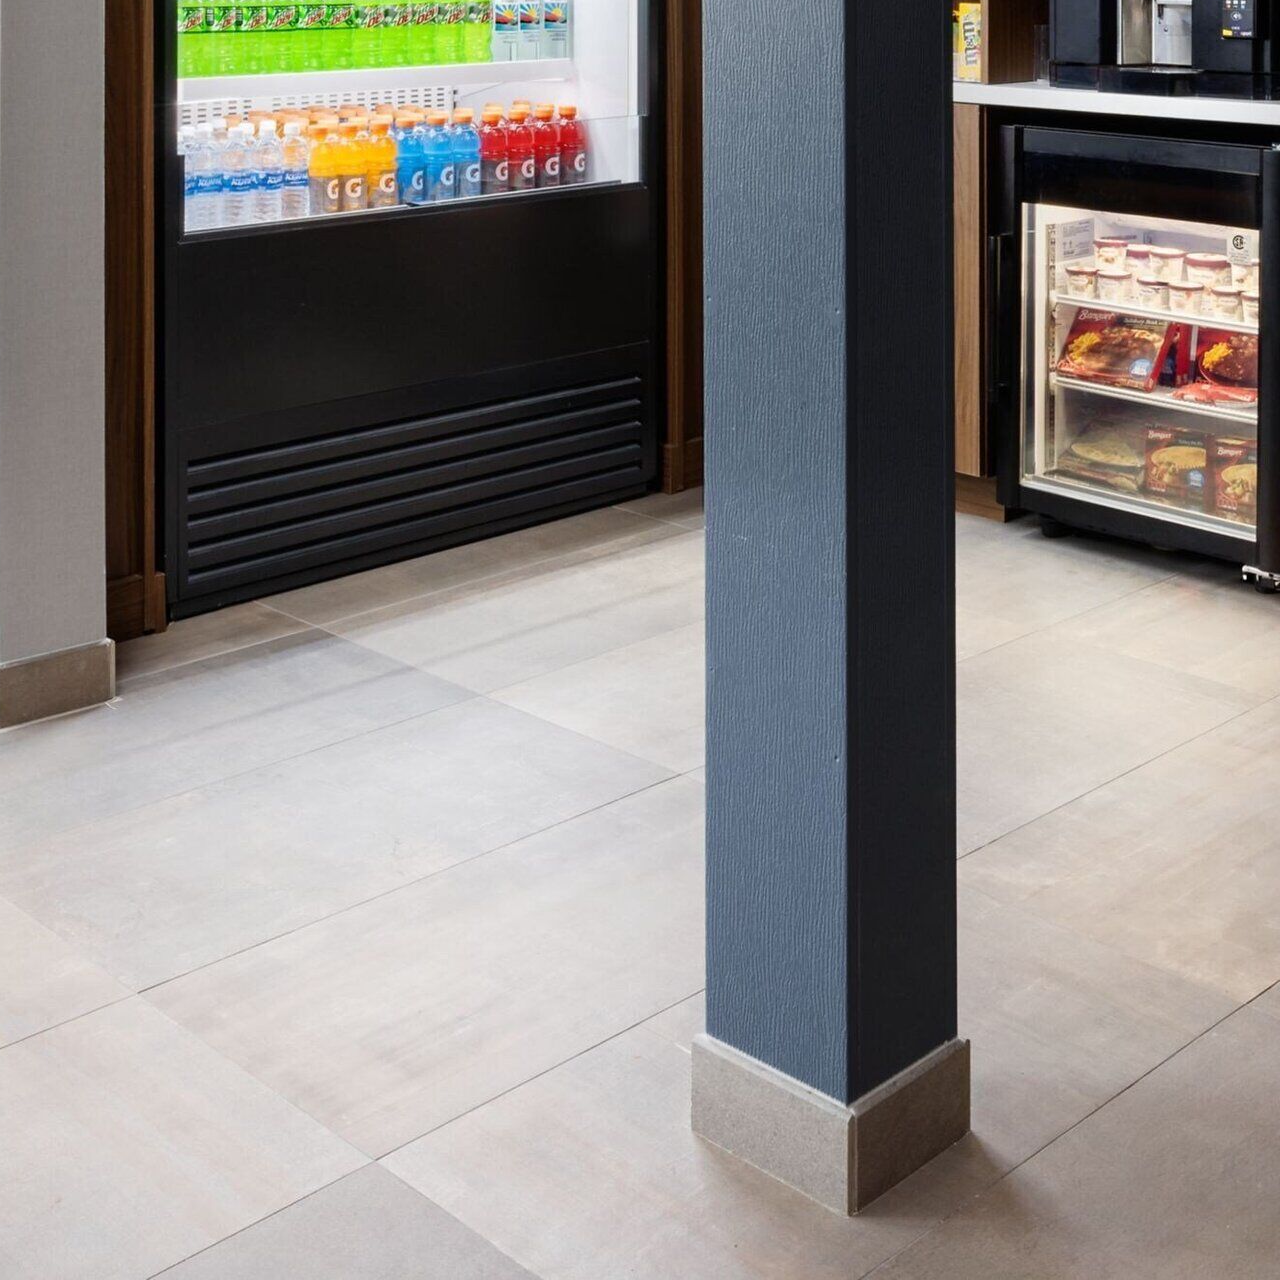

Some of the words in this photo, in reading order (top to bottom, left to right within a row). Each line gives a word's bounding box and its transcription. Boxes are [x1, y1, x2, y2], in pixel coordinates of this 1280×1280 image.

[495, 161, 508, 181] G
[521, 158, 535, 177] G
[545, 157, 559, 175] G
[574, 153, 585, 172] G
[379, 173, 395, 192] G
[440, 166, 454, 185] G
[466, 164, 480, 182] G
[345, 177, 362, 198] G
